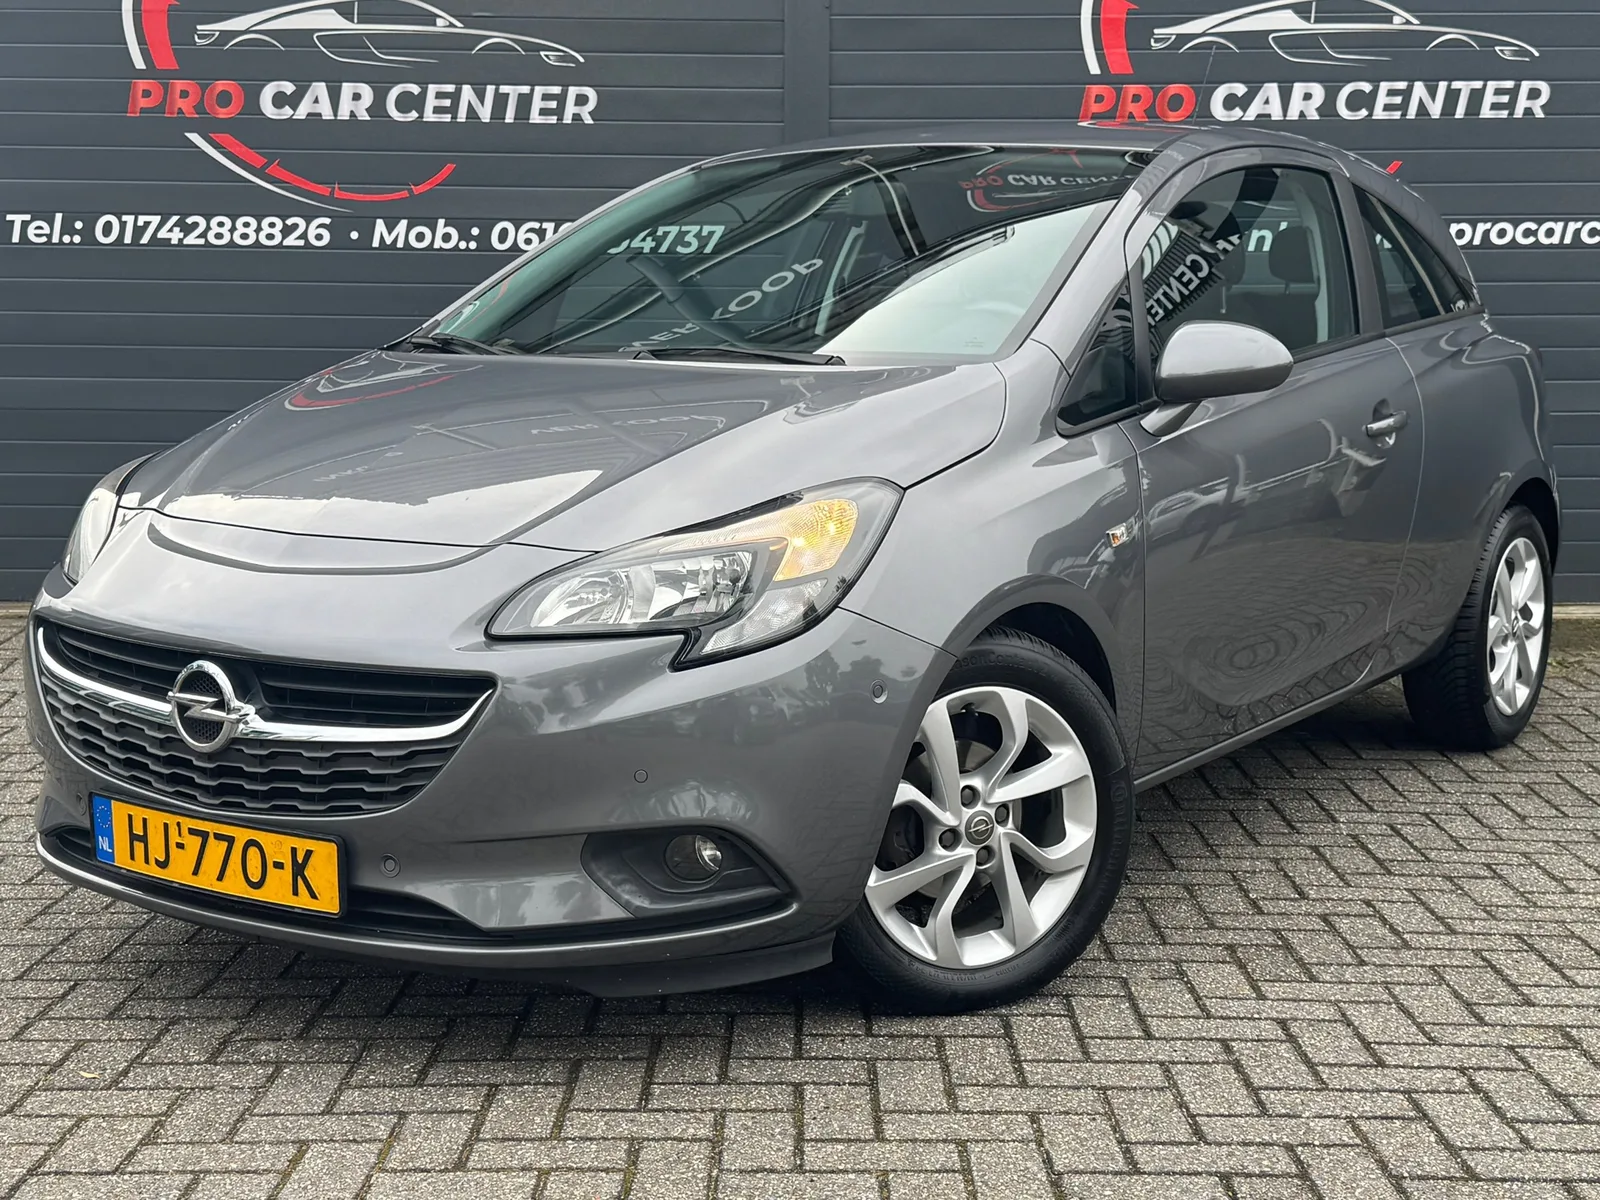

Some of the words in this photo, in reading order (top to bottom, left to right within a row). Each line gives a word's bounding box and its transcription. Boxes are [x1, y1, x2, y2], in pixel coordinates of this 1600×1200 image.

[127, 80, 245, 119] PRO
[259, 81, 374, 120] CAR
[386, 83, 599, 124] CENTER
[1079, 83, 1196, 122] PRO
[1210, 82, 1326, 121] CAR
[1336, 80, 1551, 119] CENTER
[6, 212, 84, 244] Tel.:
[95, 214, 332, 247] 0174288826
[372, 218, 480, 250] Mob.:
[98, 835, 113, 853] NL
[127, 813, 321, 901] HJ-770-K
